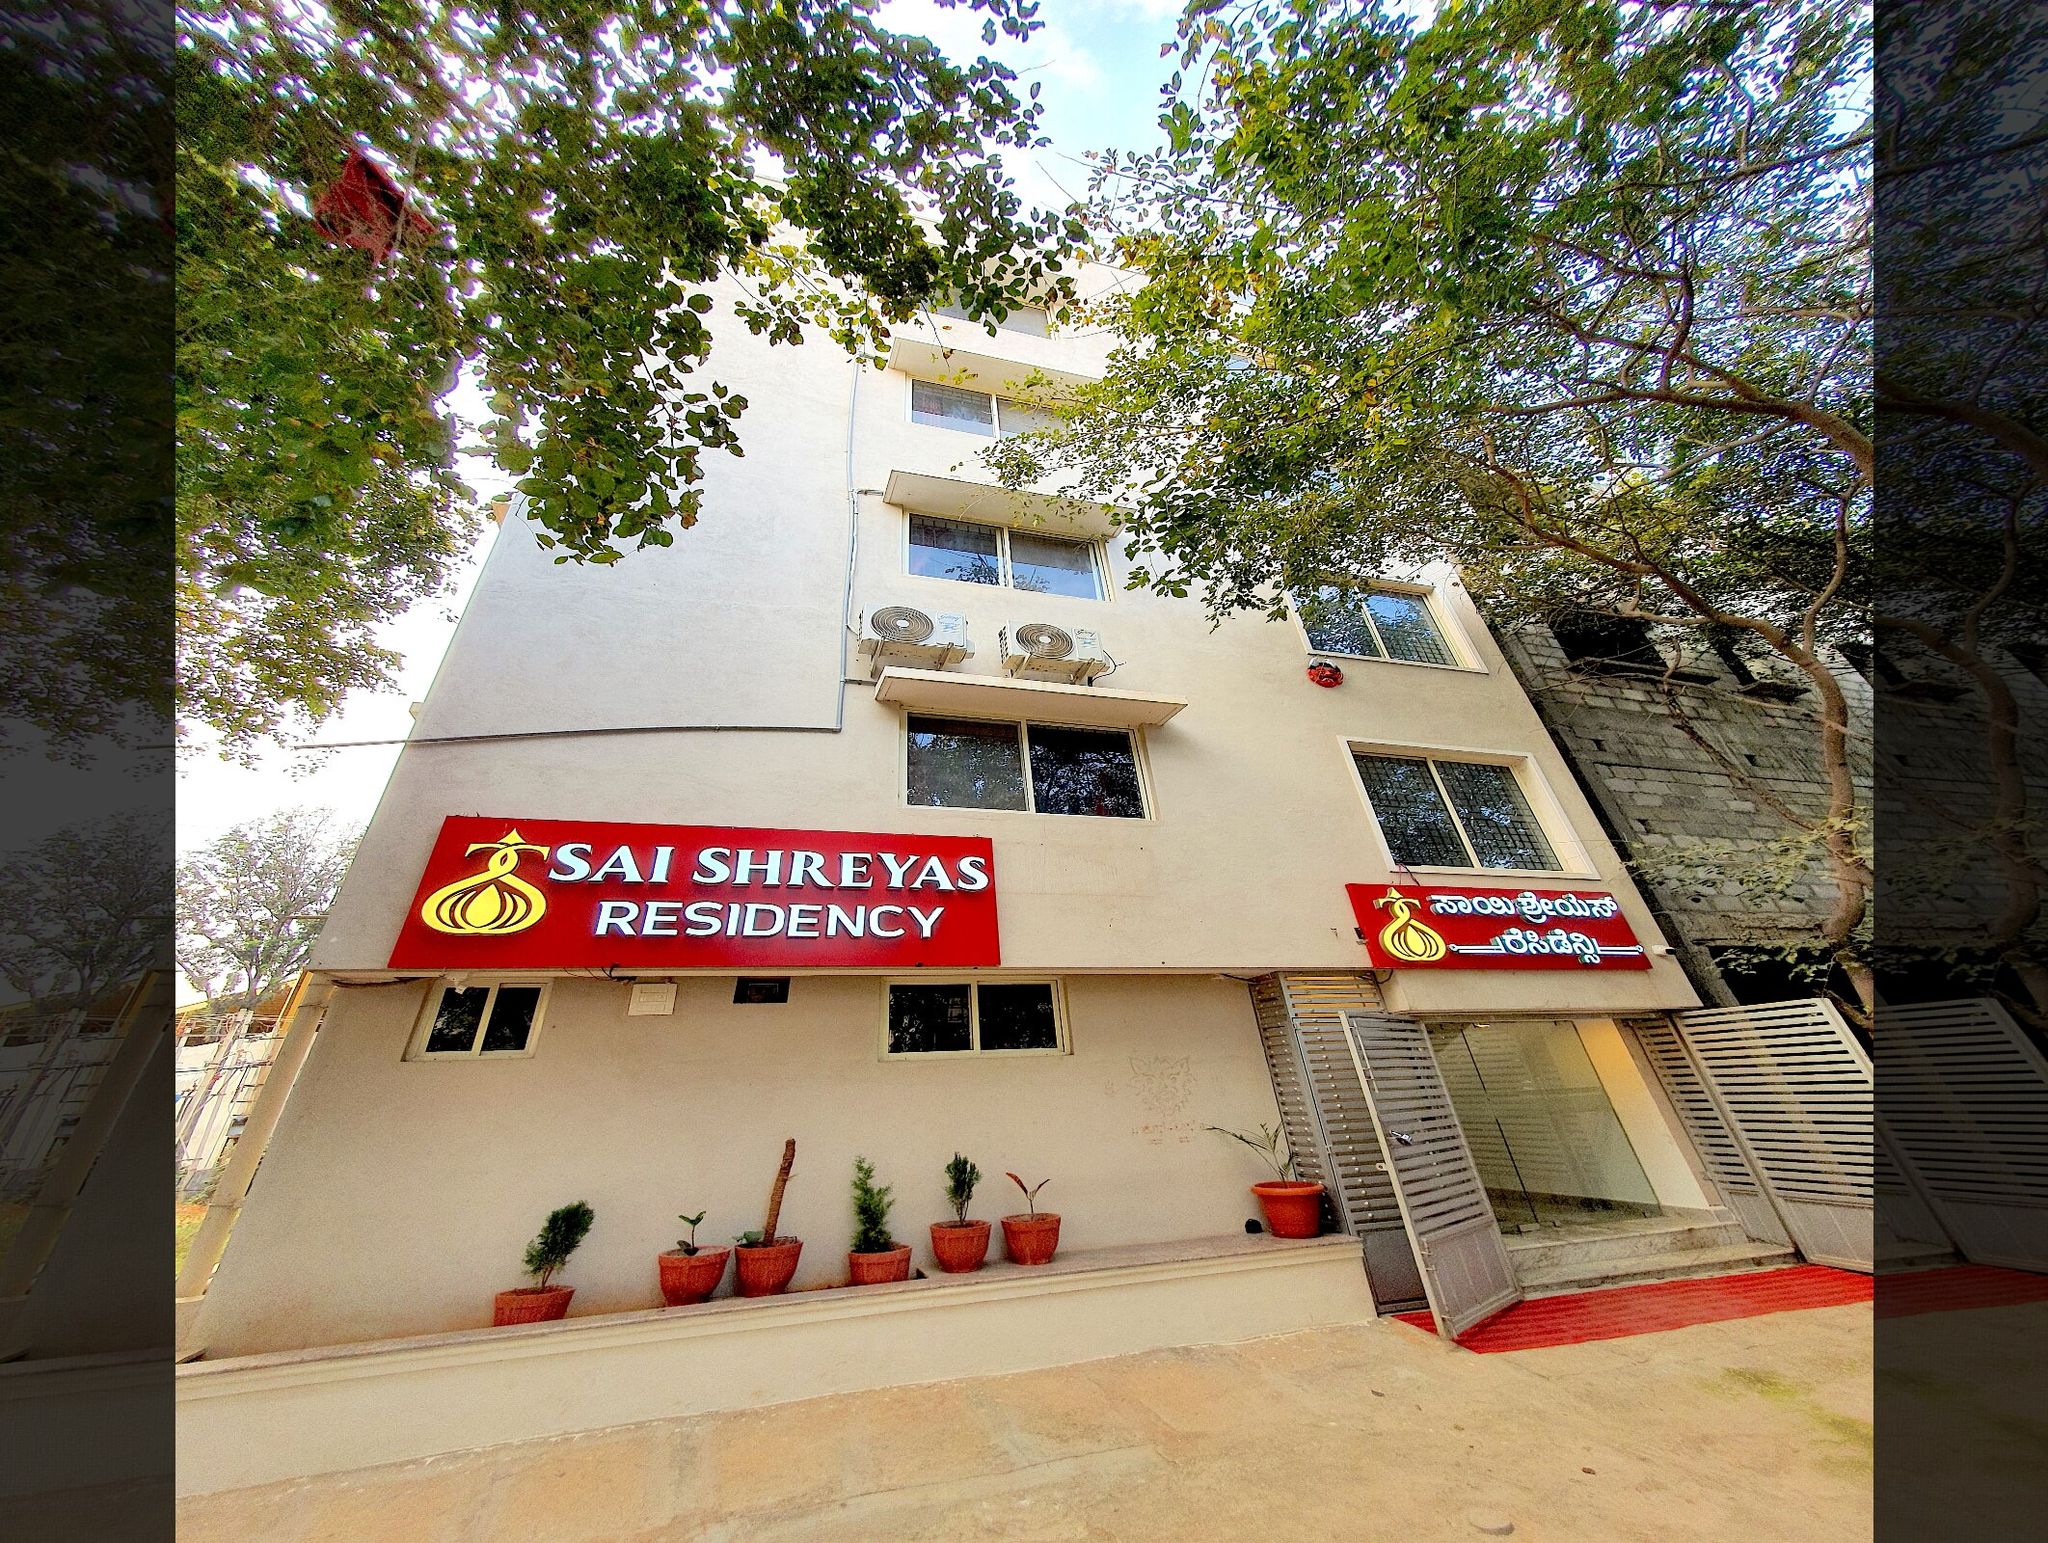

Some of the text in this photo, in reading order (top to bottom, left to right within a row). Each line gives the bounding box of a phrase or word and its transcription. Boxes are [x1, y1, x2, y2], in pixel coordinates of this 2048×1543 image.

[549, 843, 989, 891] SAI SHREYAS
[595, 901, 945, 938] RESIDENCY
[1428, 894, 1515, 915] ಸಾಯಿ
[1501, 927, 1600, 964] ರೆಸಿಡೆನ್ಸಿ
